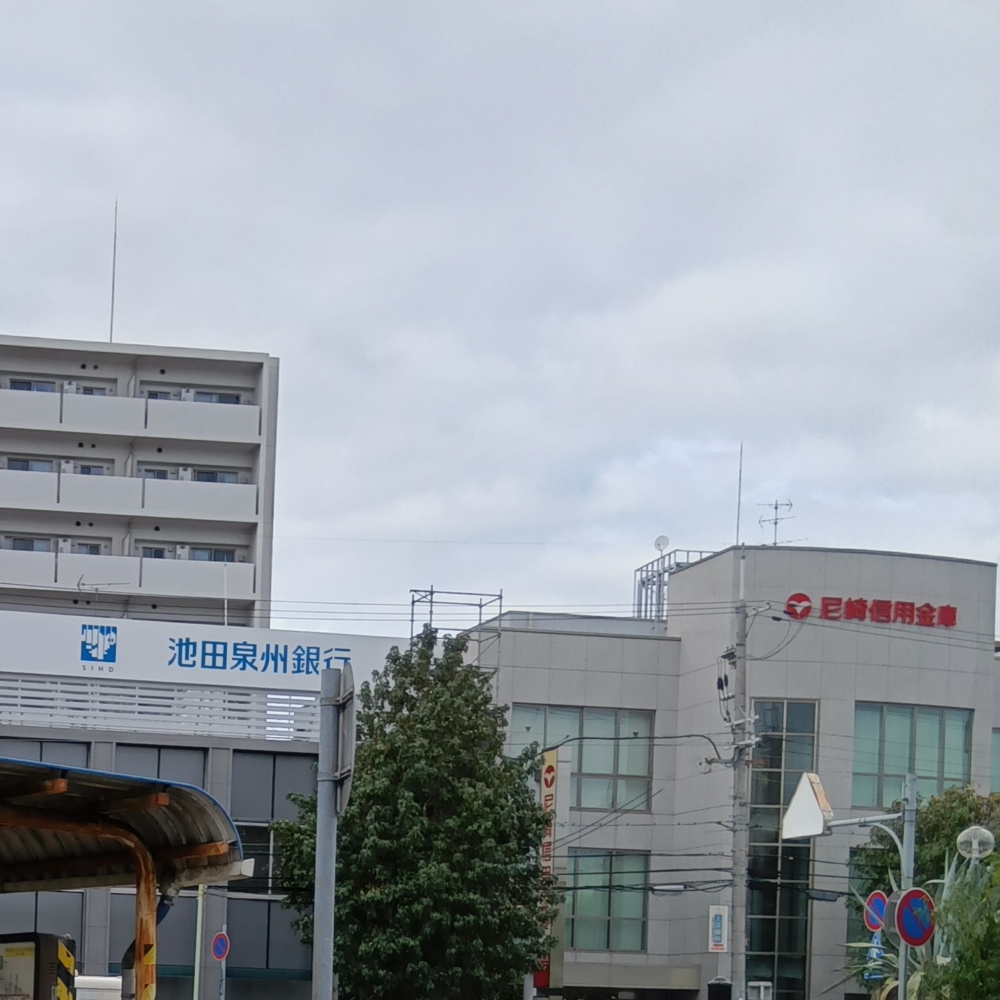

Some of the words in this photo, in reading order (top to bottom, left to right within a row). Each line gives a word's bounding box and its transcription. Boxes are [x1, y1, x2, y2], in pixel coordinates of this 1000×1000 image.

[818, 596, 958, 628] 尼崎信用金庫
[168, 637, 351, 675] 池田泉州銀行
